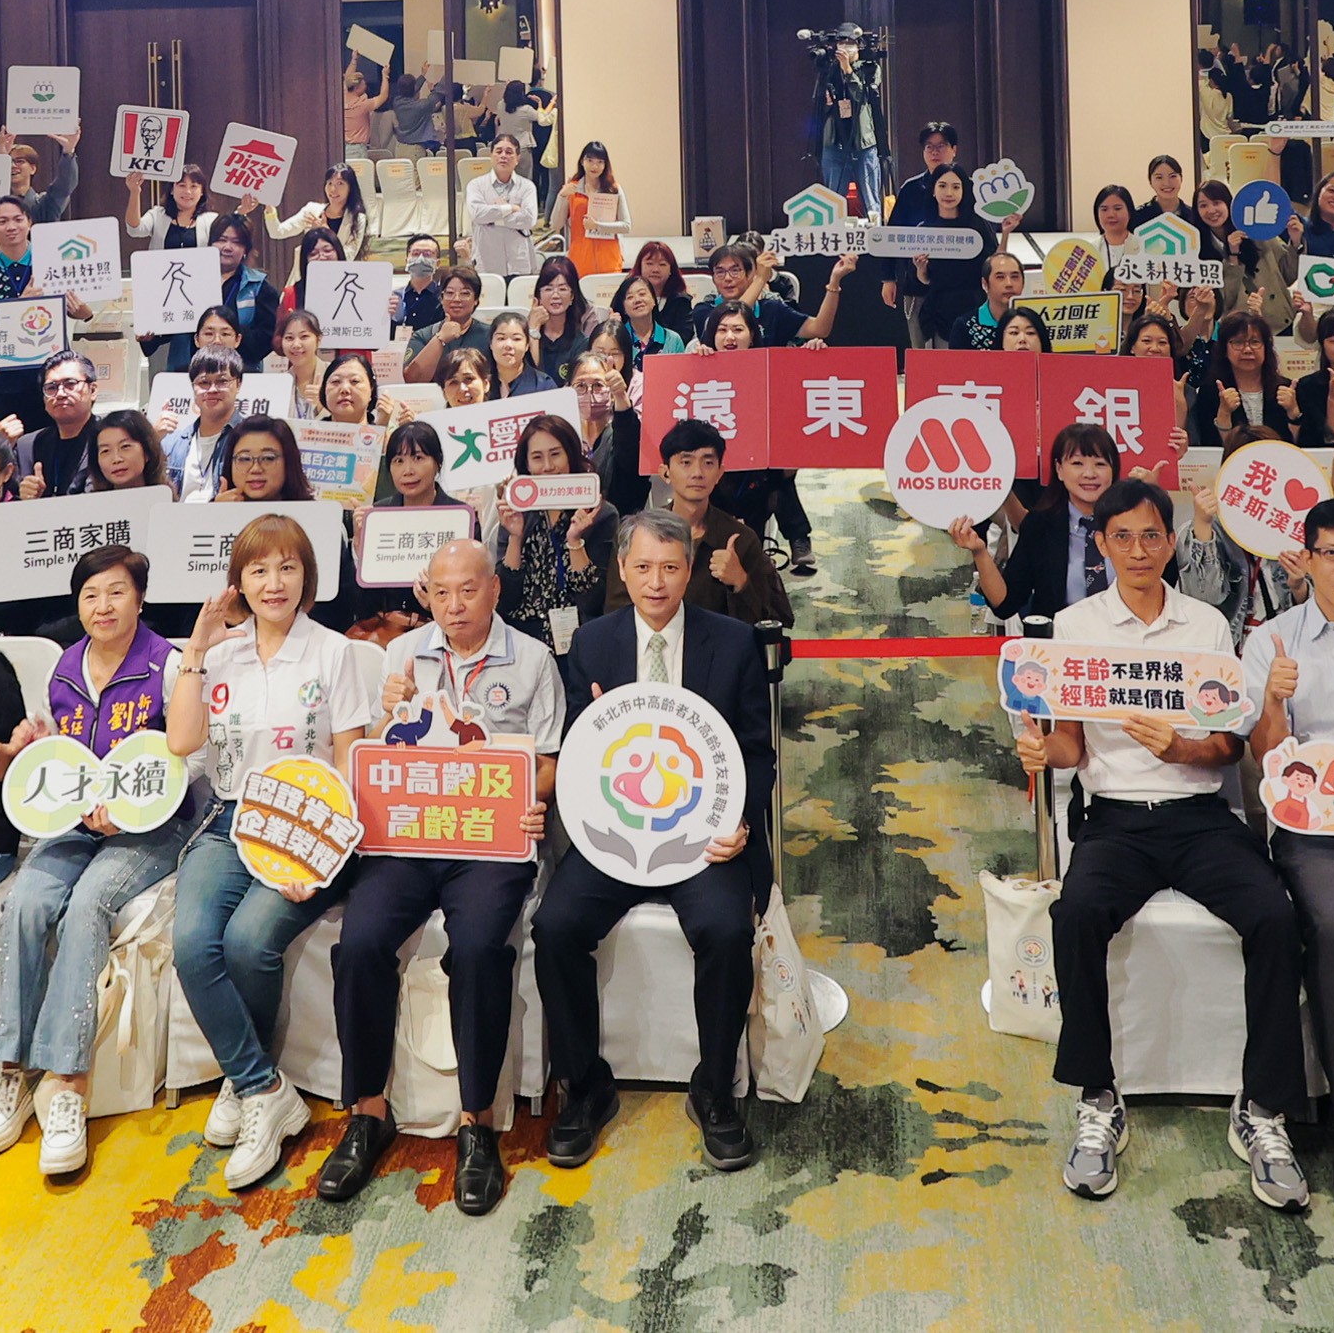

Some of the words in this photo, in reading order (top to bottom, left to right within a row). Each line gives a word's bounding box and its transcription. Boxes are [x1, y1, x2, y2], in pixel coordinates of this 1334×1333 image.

[128, 157, 166, 173] KFC
[224, 150, 281, 177] Pizza
[224, 168, 264, 191] Hut
[768, 231, 866, 253] 永耕好照
[44, 262, 111, 281] 永耕好照
[1116, 259, 1223, 286] 永耕好照
[1039, 303, 1101, 322] 人才回任
[320, 326, 373, 338] 台灣斯巴克
[168, 398, 191, 408] SUN
[305, 469, 347, 482] 和分公司
[897, 476, 935, 492] MOS
[937, 476, 1003, 492] BURGER
[1242, 459, 1278, 497] 我
[539, 486, 593, 499] 魅力的美廉社
[1220, 484, 1306, 545] 摩斯漢堡
[25, 520, 131, 554] 三商家購
[376, 531, 456, 551] 三商家購
[24, 554, 65, 569] Simple
[187, 560, 229, 572] Simple
[376, 553, 404, 563] Simple
[407, 552, 428, 561] Mart
[1063, 657, 1184, 683] 年齡不是界線
[210, 682, 230, 715] 9
[1060, 684, 1186, 711] 經驗就是價值
[71, 703, 84, 735] 主任
[592, 694, 732, 829] 新北市中高齡者及高齡者友善職場
[23, 760, 167, 805] 人才永續
[369, 759, 513, 799] 中高齡及
[241, 772, 358, 852] 認證肯定
[387, 805, 495, 843] 高齡者
[237, 807, 342, 881] 企業榮耀
